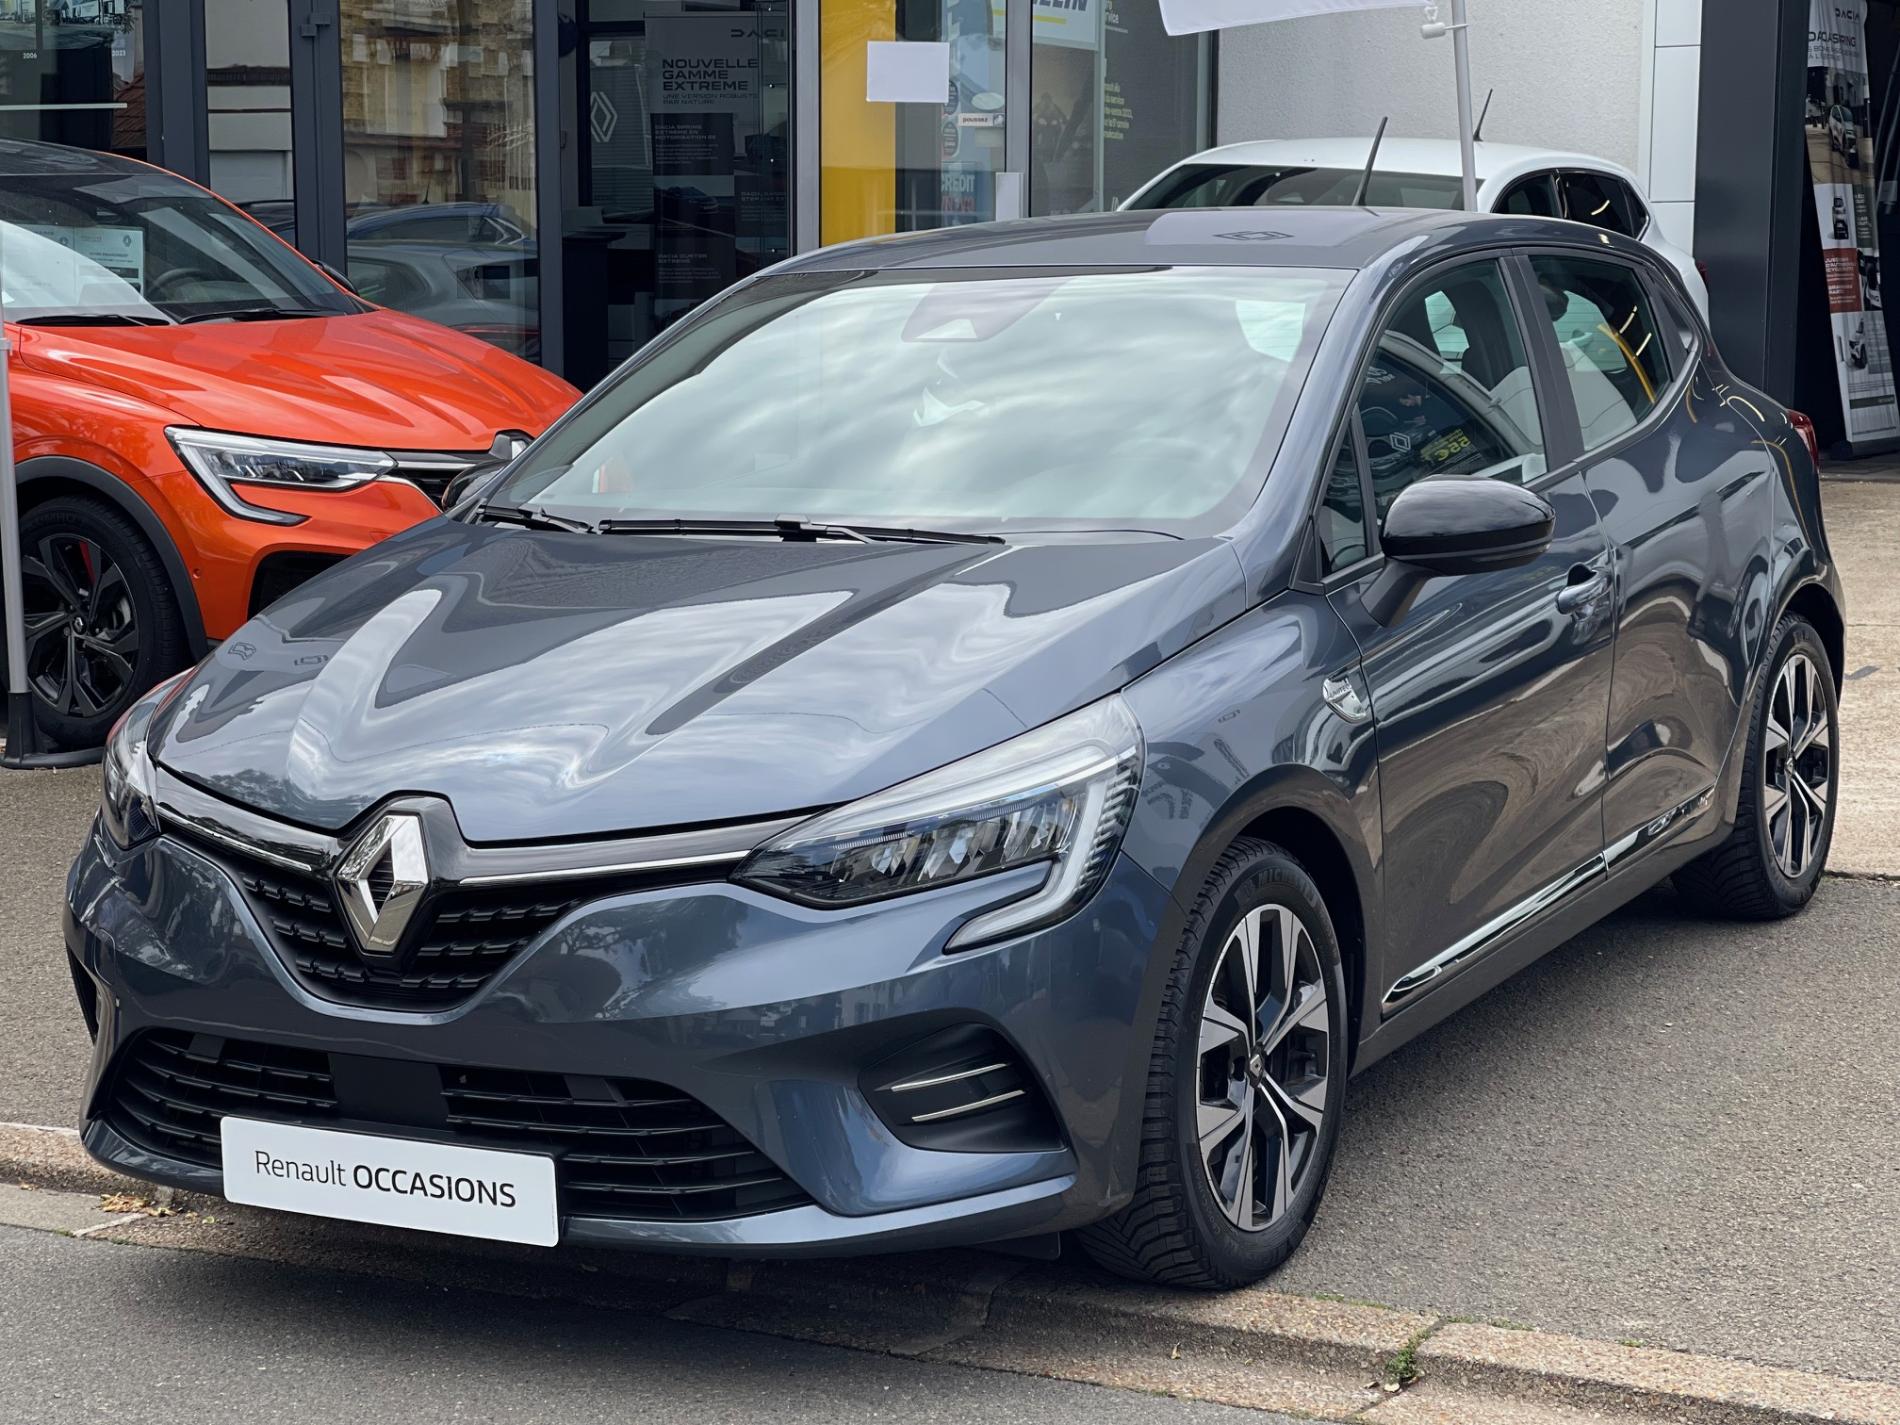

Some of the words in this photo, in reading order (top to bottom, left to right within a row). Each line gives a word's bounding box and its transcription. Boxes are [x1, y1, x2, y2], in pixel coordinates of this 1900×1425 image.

[662, 59, 760, 68] NOUVELLE
[662, 70, 729, 80] GAMME
[663, 81, 748, 91] EXTREME
[255, 1151, 347, 1186] Renault
[352, 1164, 516, 1208] OCCASIONS
